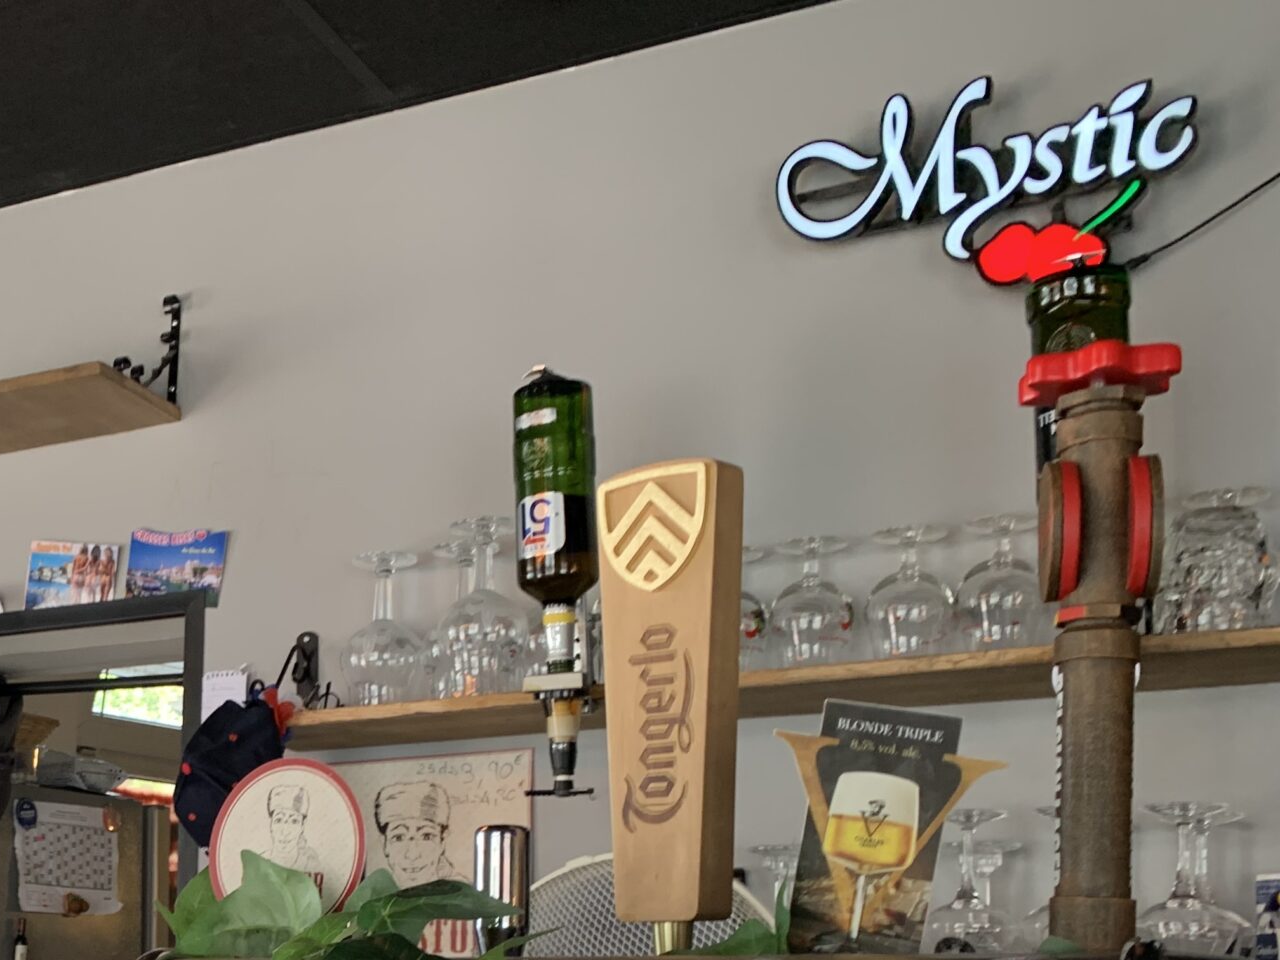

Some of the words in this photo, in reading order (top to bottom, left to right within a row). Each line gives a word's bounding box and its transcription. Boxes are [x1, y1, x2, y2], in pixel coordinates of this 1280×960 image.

[776, 76, 1197, 260] Mystic
[622, 623, 695, 834] Tongerlo
[837, 717, 894, 736] BLONDE
[895, 725, 944, 743] TRIPLE
